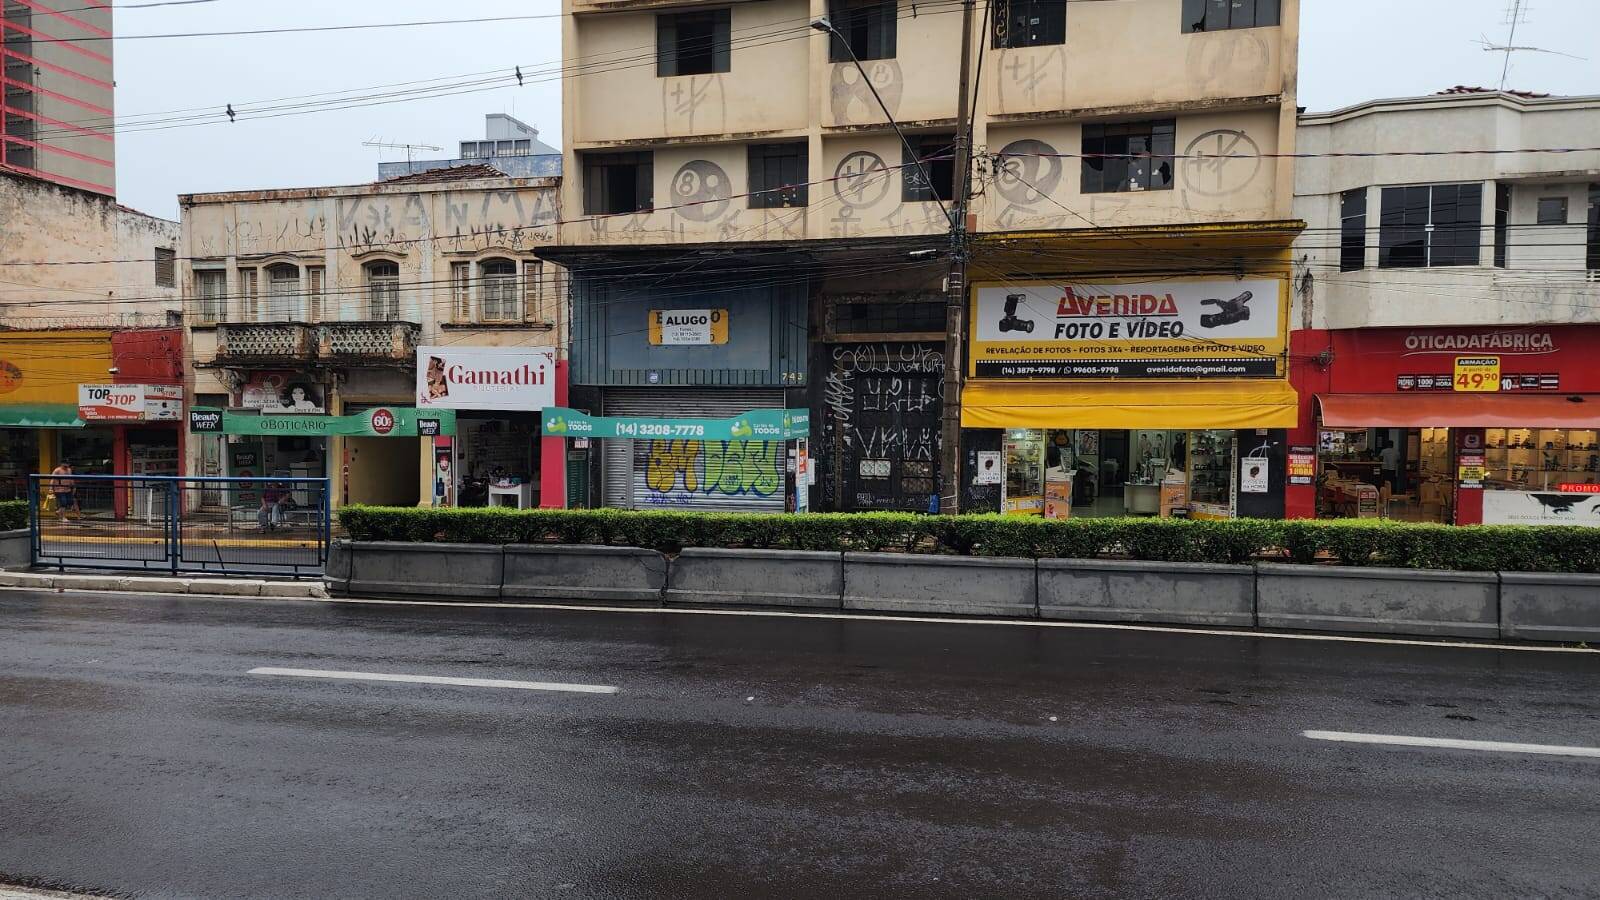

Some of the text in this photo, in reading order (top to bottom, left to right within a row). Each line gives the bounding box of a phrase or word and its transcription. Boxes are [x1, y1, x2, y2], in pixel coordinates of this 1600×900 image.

[666, 315, 708, 325] ALUGO
[1054, 317, 1184, 339] FOTO E VÍDEO
[985, 346, 1031, 355] REVELAÇÃO
[1130, 345, 1190, 353] REPORTAGENS
[448, 364, 545, 385] Gamathi
[1001, 365, 1246, 375] (14) 3879-9798 99605-9798 avenidafoto@gmail.com
[782, 372, 803, 381] 743
[88, 389, 110, 399] TOP
[106, 394, 136, 405] STOP
[191, 412, 220, 424] Beauty
[196, 421, 216, 429] WEEK
[419, 420, 438, 429] Beauty
[567, 424, 592, 432] TODOS
[615, 422, 704, 436] (14) 3208-7778
[753, 427, 780, 435] TODOS
